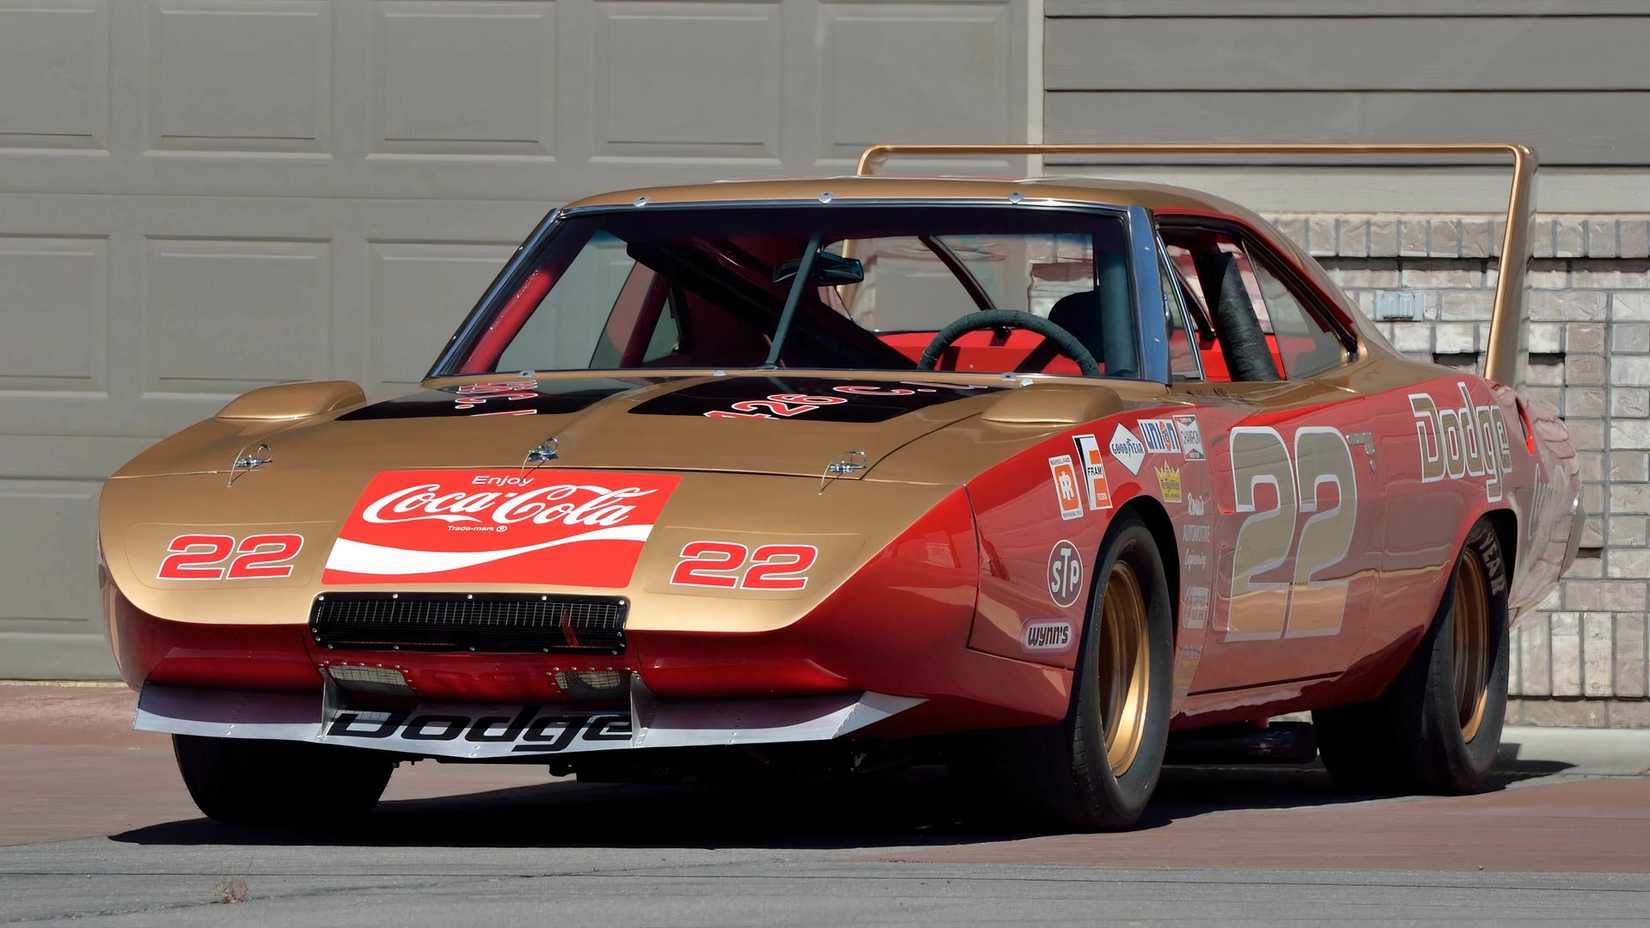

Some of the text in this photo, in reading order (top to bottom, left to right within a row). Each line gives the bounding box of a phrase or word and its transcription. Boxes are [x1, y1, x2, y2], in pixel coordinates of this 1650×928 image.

[1408, 381, 1512, 503] Dodge
[471, 474, 535, 488] Enjoy
[1087, 466, 1104, 477] FRAM
[362, 483, 659, 527] Coca-Cola
[157, 533, 305, 580] 22
[1225, 426, 1357, 642] 22
[670, 540, 819, 592] 22
[1051, 547, 1080, 598] STP
[327, 705, 633, 753] Dodge
